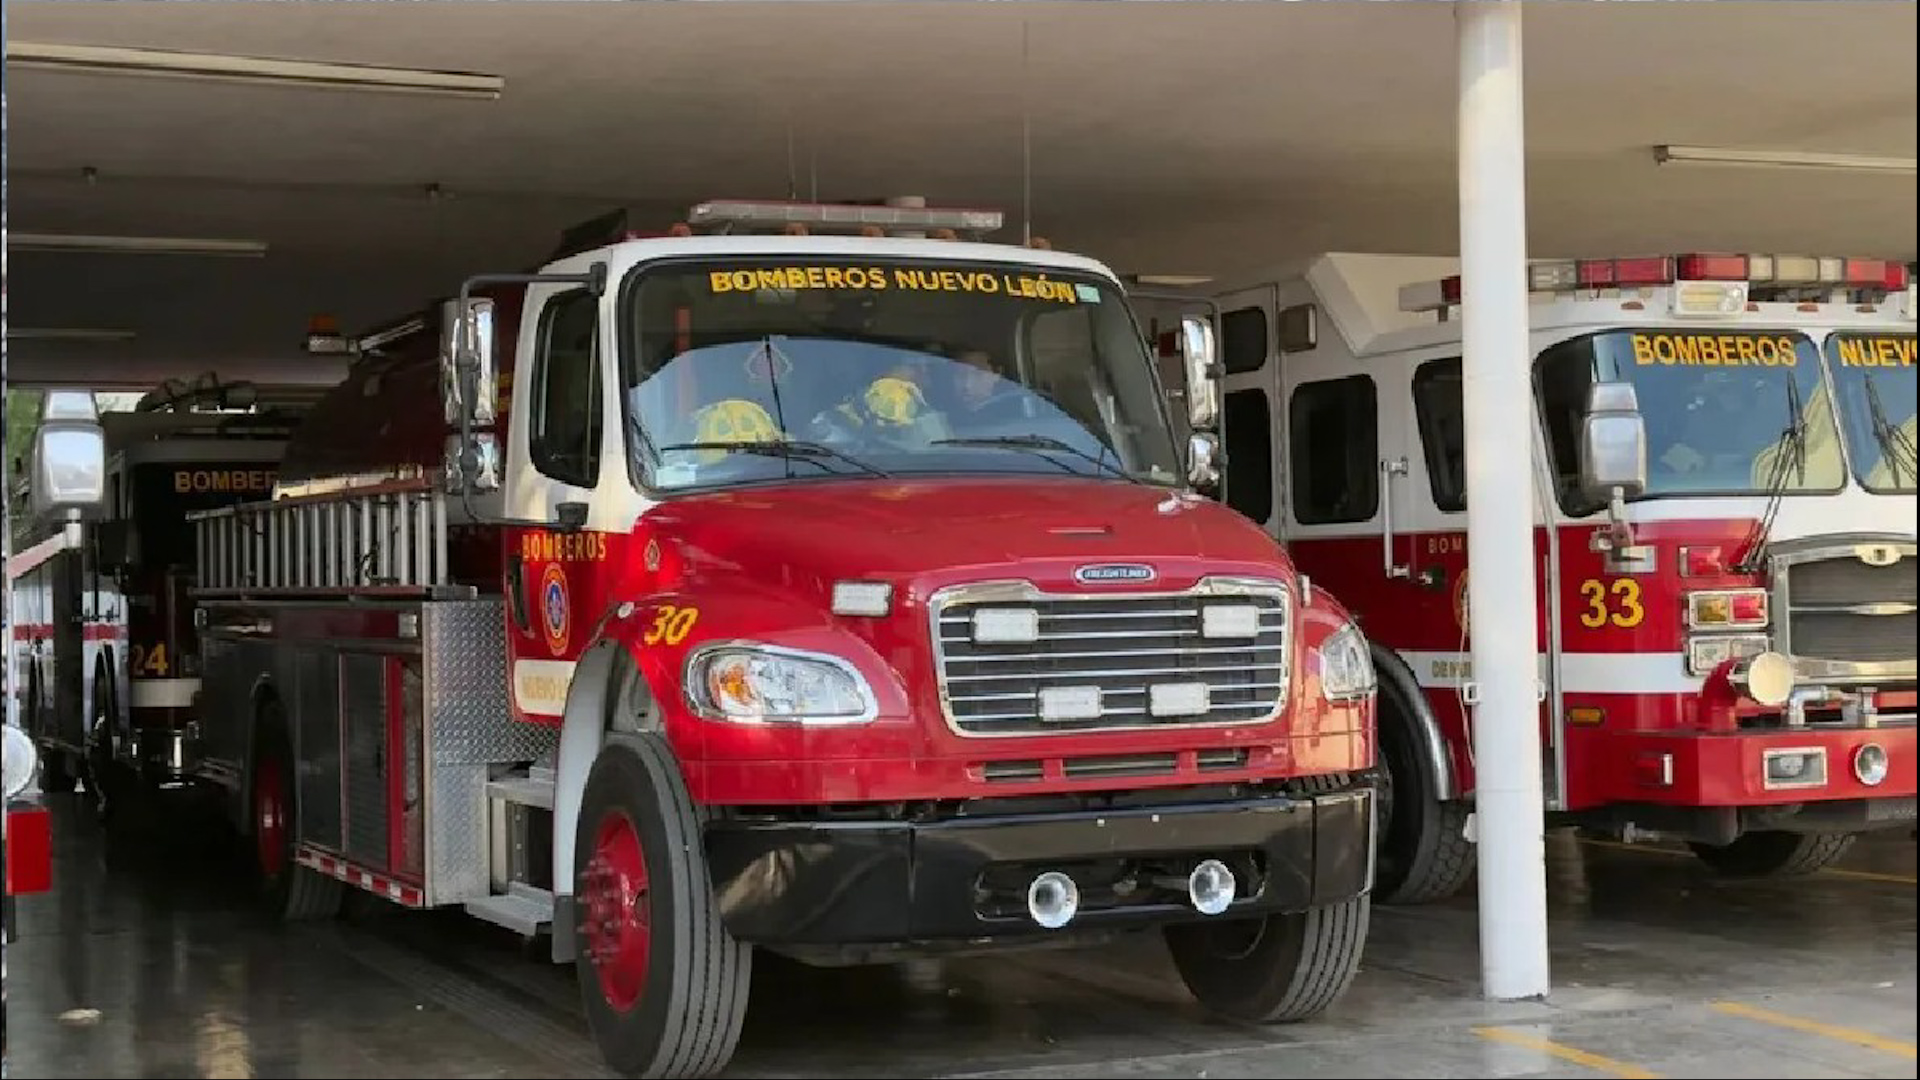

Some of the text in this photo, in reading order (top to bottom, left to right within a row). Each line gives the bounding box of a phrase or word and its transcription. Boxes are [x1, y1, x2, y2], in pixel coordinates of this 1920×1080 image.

[710, 267, 1076, 304] BOMBEROS NUEVO LEÓN
[1631, 334, 1917, 367] BOMBEROS NUEV
[522, 532, 606, 562] BOMBEROS
[1580, 578, 1644, 628] 33
[644, 605, 698, 645] 30
[132, 643, 169, 676] 24
